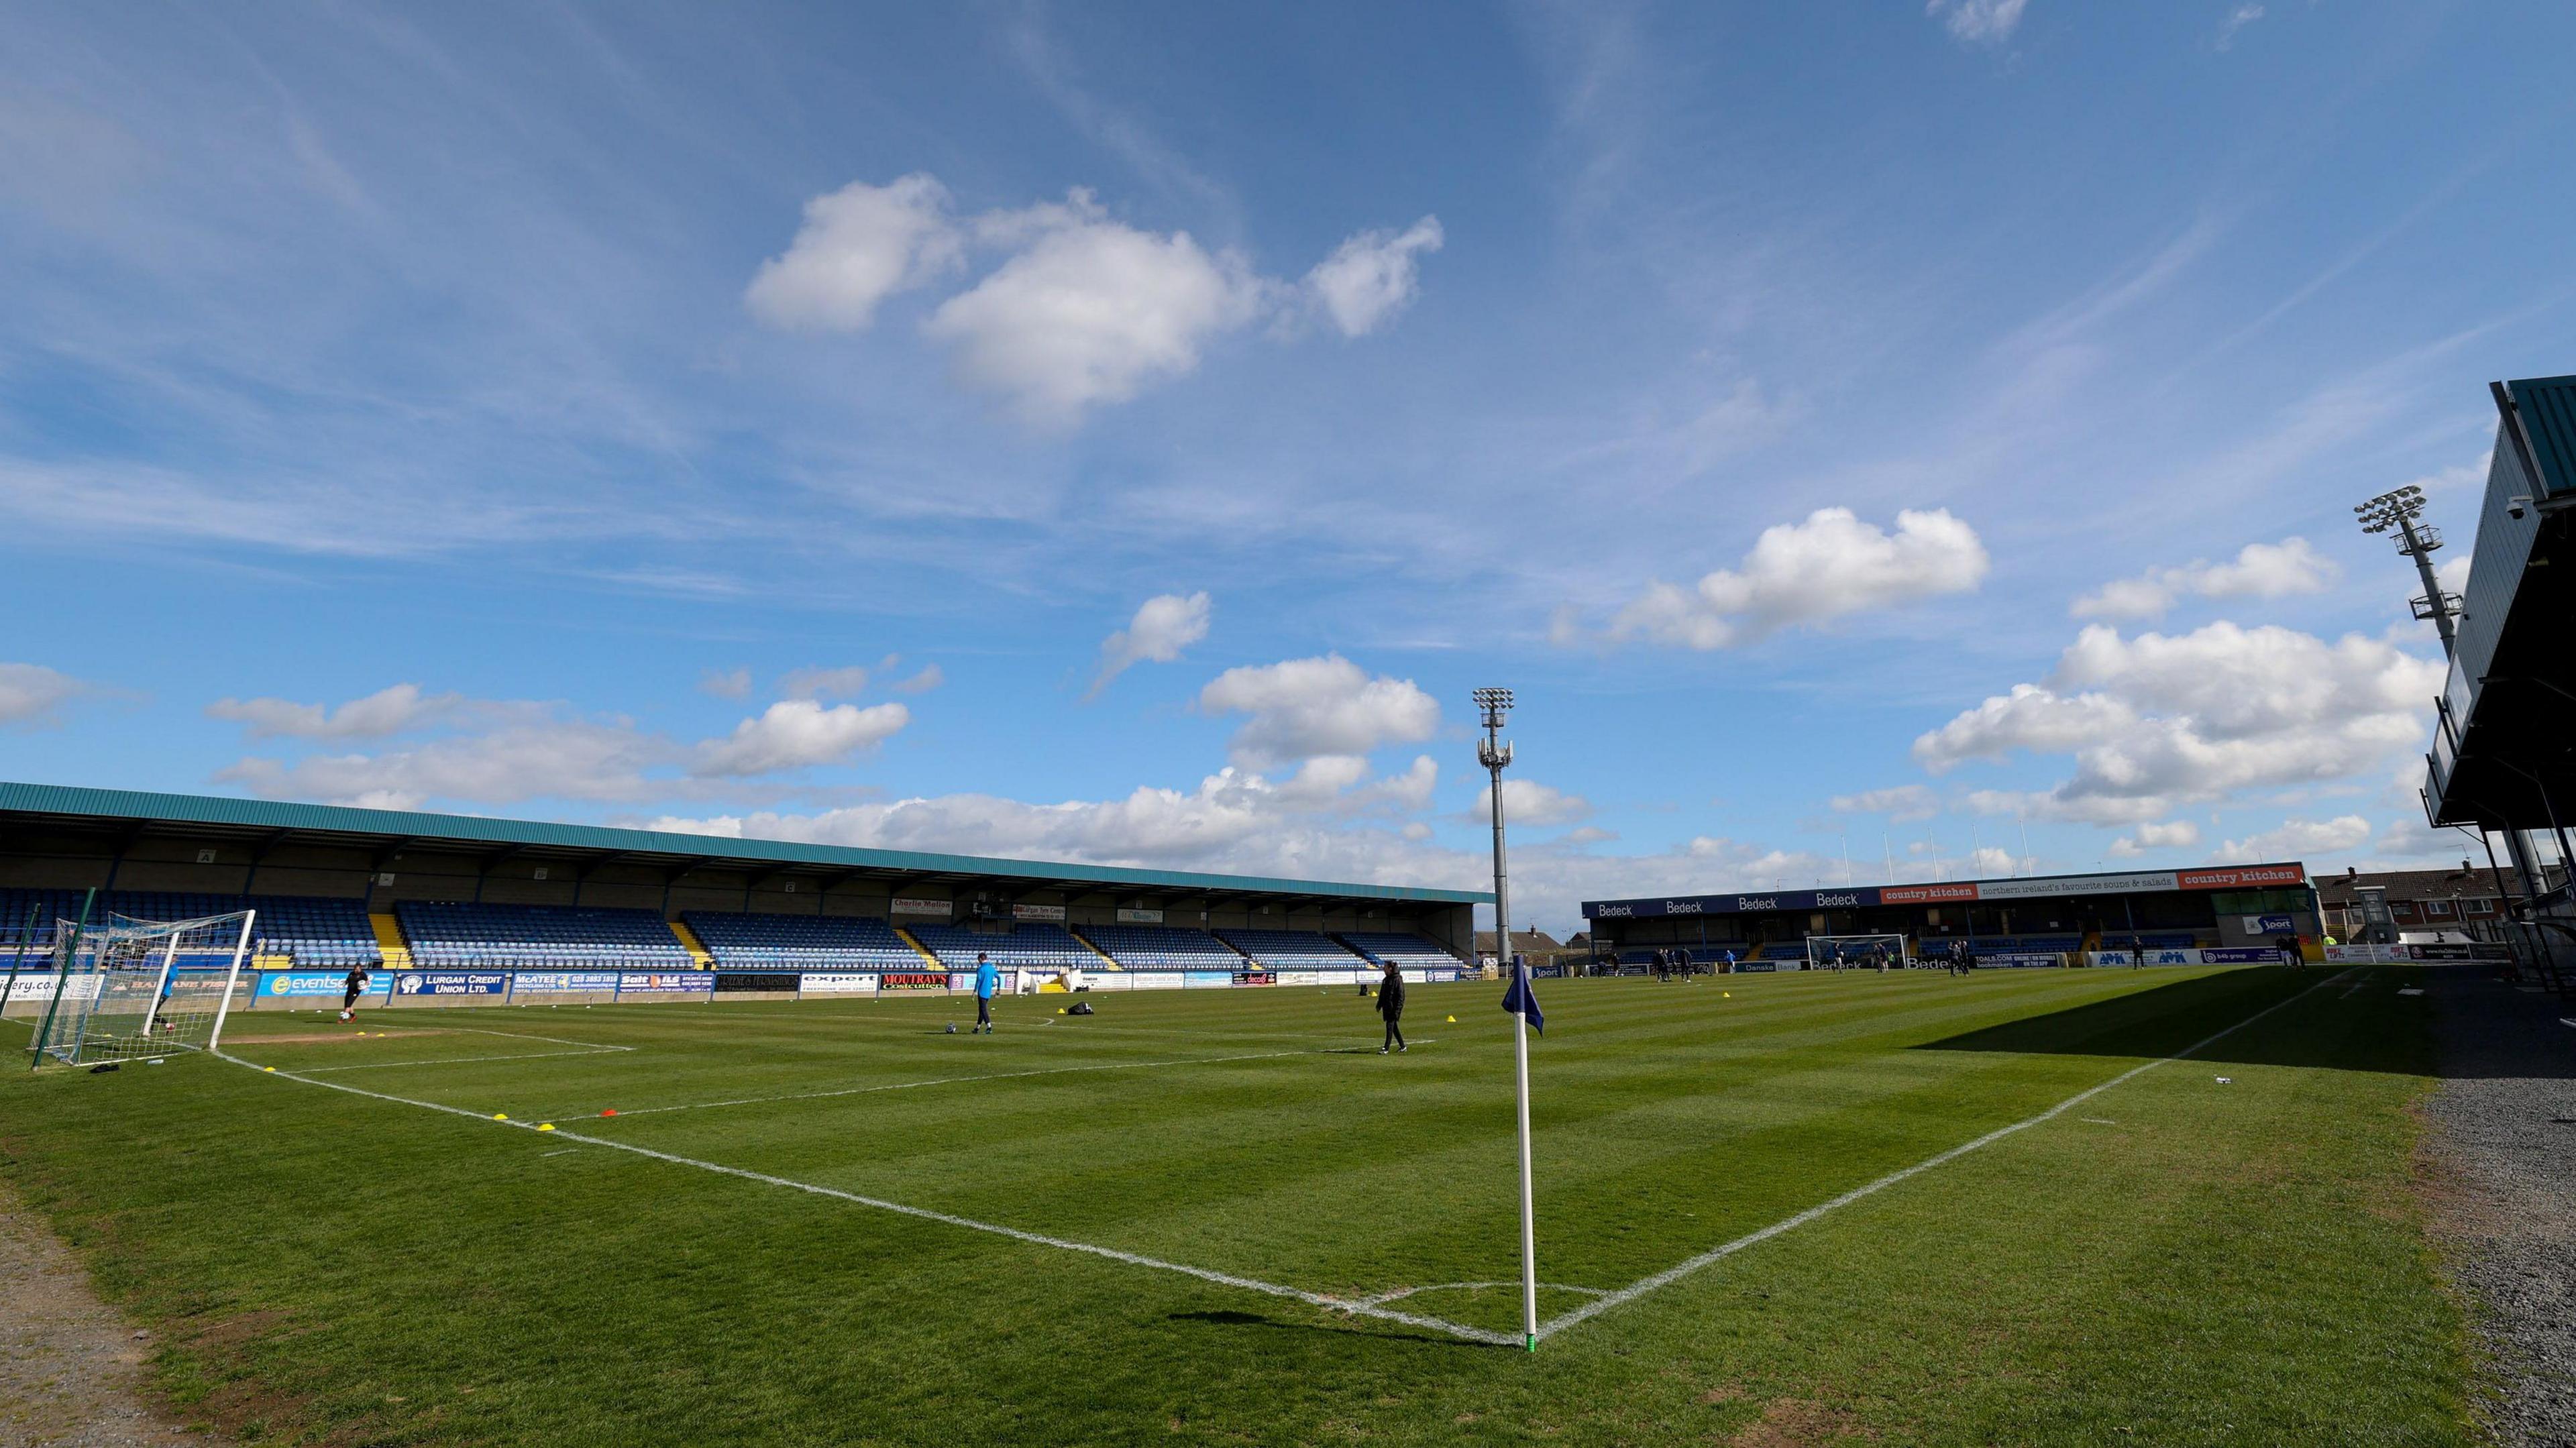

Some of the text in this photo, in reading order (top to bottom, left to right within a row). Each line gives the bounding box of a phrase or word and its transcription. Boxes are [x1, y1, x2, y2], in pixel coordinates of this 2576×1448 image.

[2185, 871, 2294, 883] country kitchen
[1983, 886, 2020, 895] northern
[2023, 884, 2059, 893] ireland's
[2062, 883, 2102, 891] favourite
[2104, 881, 2130, 889] soups
[2142, 878, 2172, 886] salads
[1817, 893, 1858, 906] Bedeck
[1886, 888, 1972, 900] country kitchen
[1666, 901, 1703, 913] Bedeck
[1739, 897, 1777, 910] Bedeck
[1599, 905, 1632, 916] Bedeck
[426, 974, 502, 985] LURGAN CREDIT
[516, 976, 557, 984] McATEE
[883, 975, 947, 985] MOUTRAY'S
[435, 985, 488, 994] UNION LTD.
